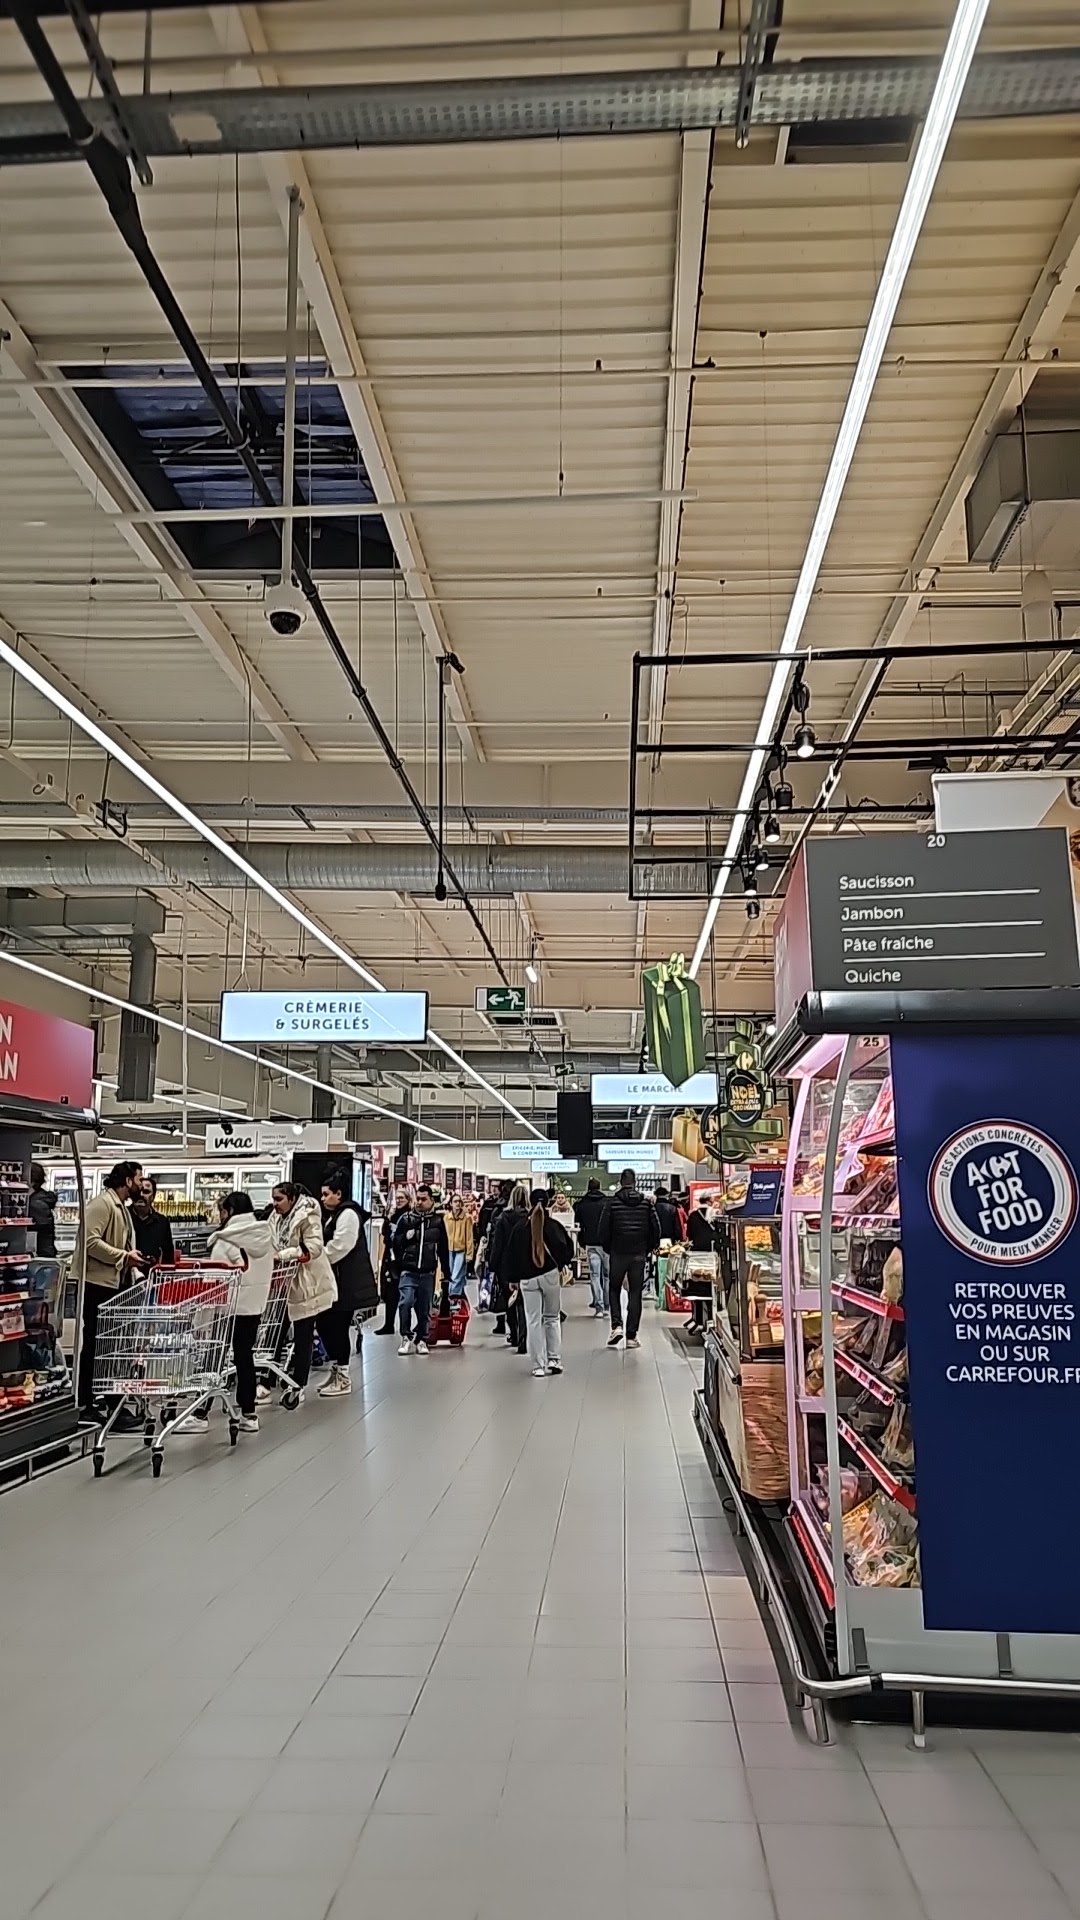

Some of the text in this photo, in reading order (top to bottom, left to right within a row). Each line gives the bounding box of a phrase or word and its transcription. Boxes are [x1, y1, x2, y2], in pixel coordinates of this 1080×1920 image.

[927, 835, 946, 848] 20
[839, 875, 914, 890] Saucisson
[841, 906, 904, 921] Jambon
[843, 936, 934, 952] Pâte fraîche
[845, 969, 902, 984] Quiche
[284, 1000, 362, 1013] CRÈMERIE
[276, 1016, 369, 1030] & SURGELÉS
[863, 1037, 880, 1047] 25
[627, 1085, 638, 1093] LE
[730, 1084, 760, 1100] NOËL
[214, 1137, 253, 1149] vrac
[939, 1129, 1044, 1178] DES ACTIONS CONCRÈTES
[977, 1176, 1028, 1209] FOR
[978, 1198, 1044, 1235] FOOD
[970, 1217, 1063, 1257] POUR MIEUX MANGER
[955, 1283, 1066, 1299] RETROUVER
[949, 1303, 1075, 1320] VOS PREUVES
[955, 1324, 1071, 1341] EN MAGASIN
[980, 1345, 1051, 1361] OU SUR
